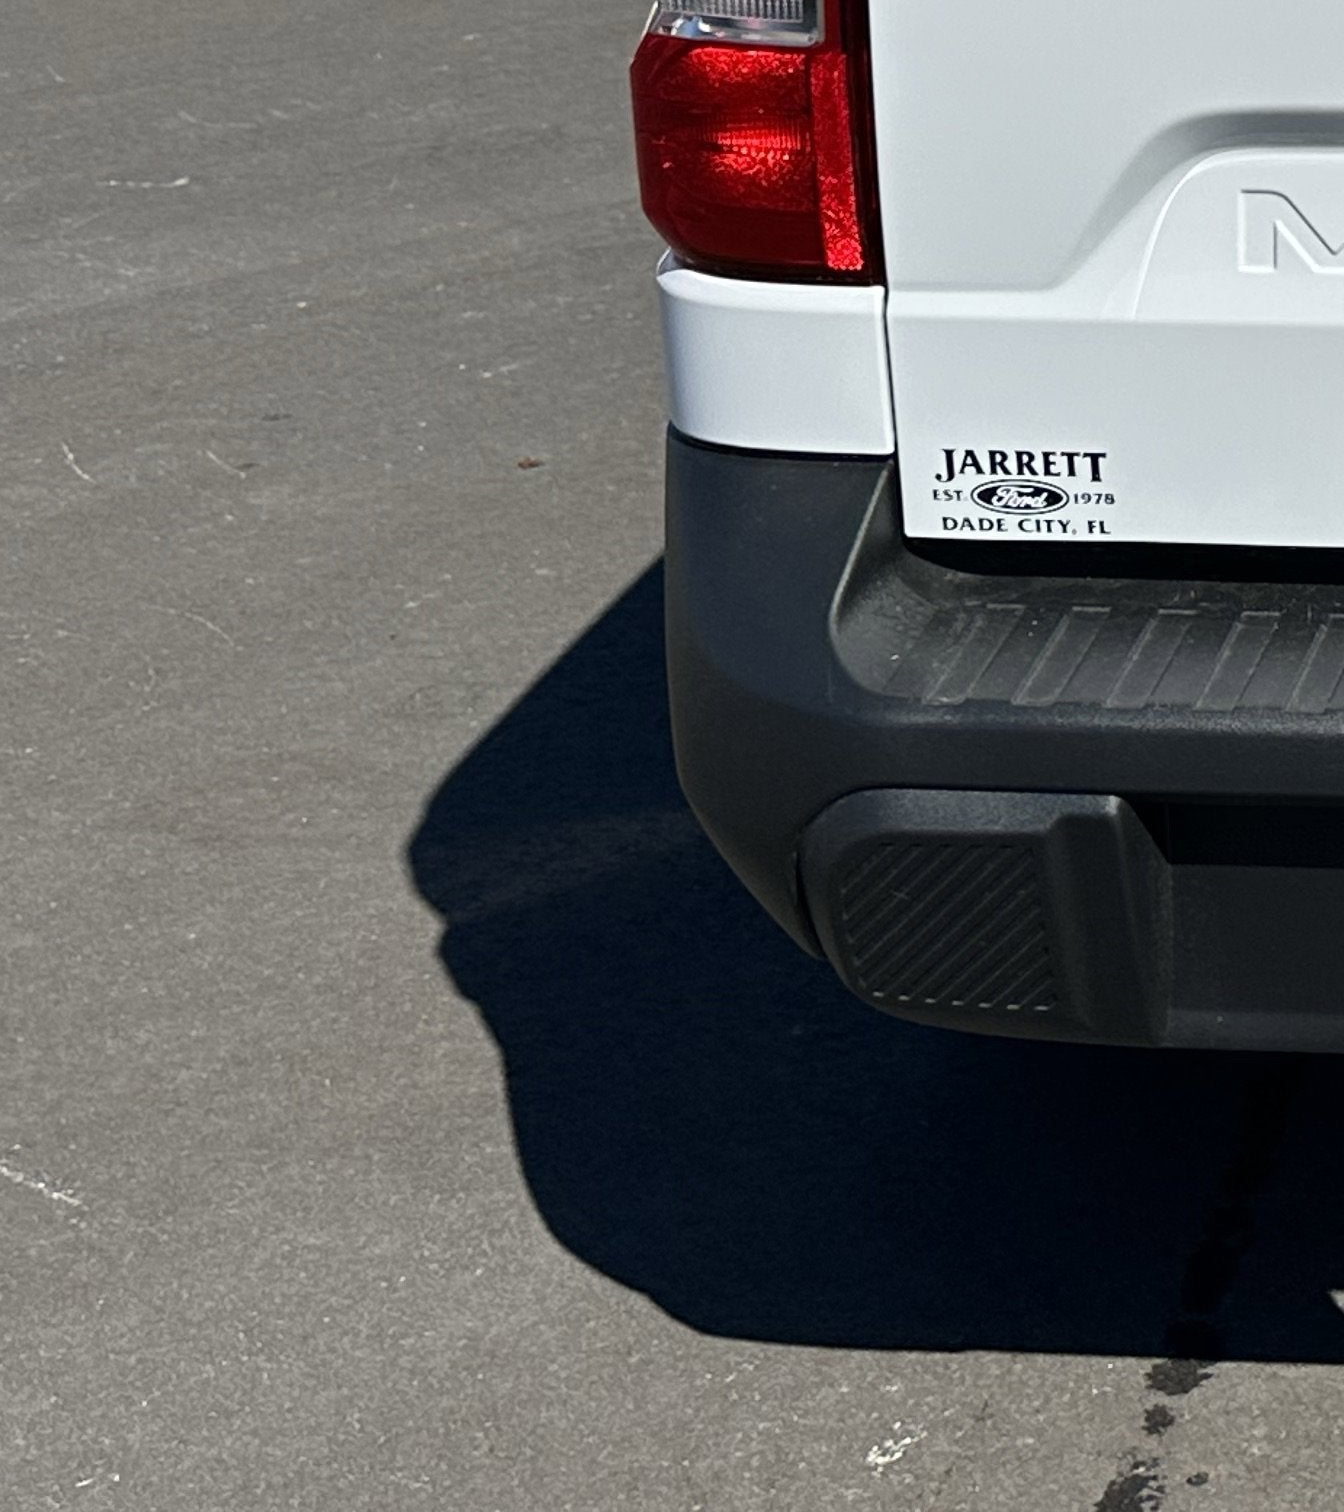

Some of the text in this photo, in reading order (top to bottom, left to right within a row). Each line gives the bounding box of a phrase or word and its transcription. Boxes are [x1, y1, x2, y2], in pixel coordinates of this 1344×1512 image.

[935, 448, 1107, 482] JARRETT
[991, 487, 1048, 507] Ford
[1074, 492, 1115, 505] 1978
[942, 517, 1009, 533] DADE
[1087, 520, 1112, 535] FL
